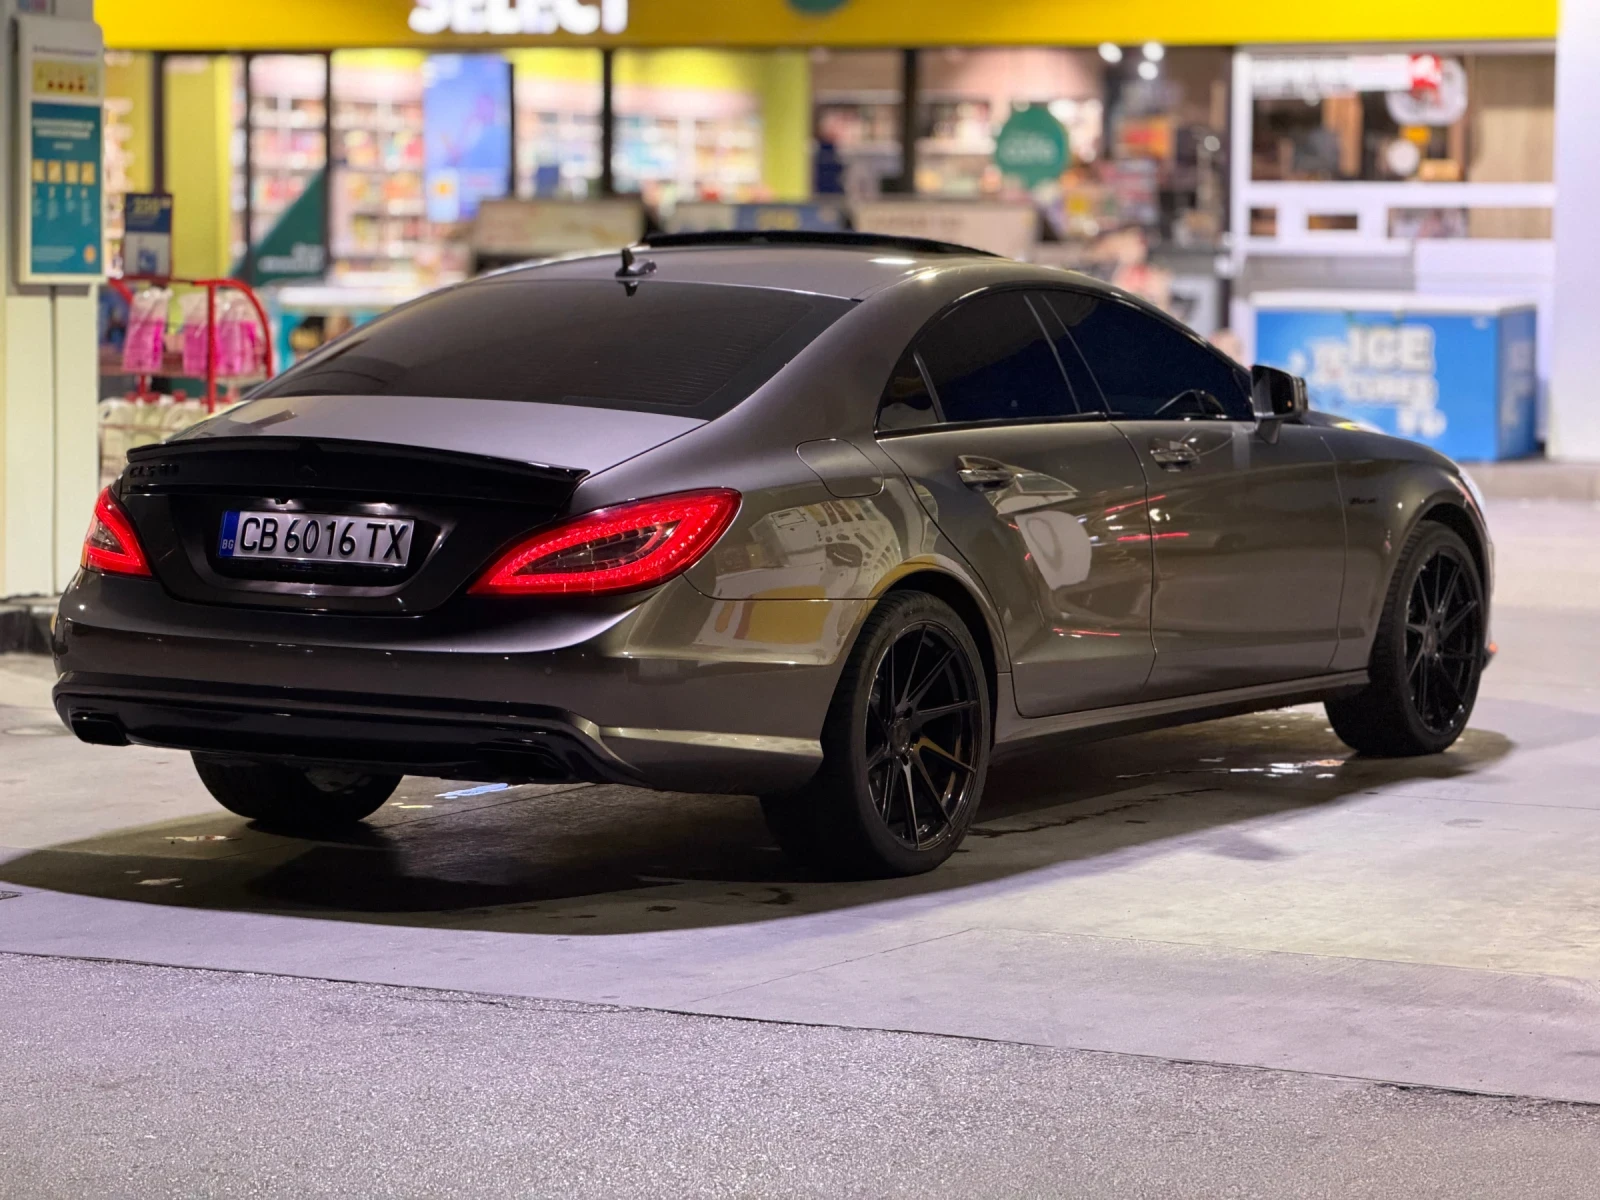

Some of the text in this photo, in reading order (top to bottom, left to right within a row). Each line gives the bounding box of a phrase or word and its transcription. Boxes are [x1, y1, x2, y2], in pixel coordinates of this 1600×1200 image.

[221, 539, 234, 550] BG
[240, 517, 409, 560] CB 6016 TX
